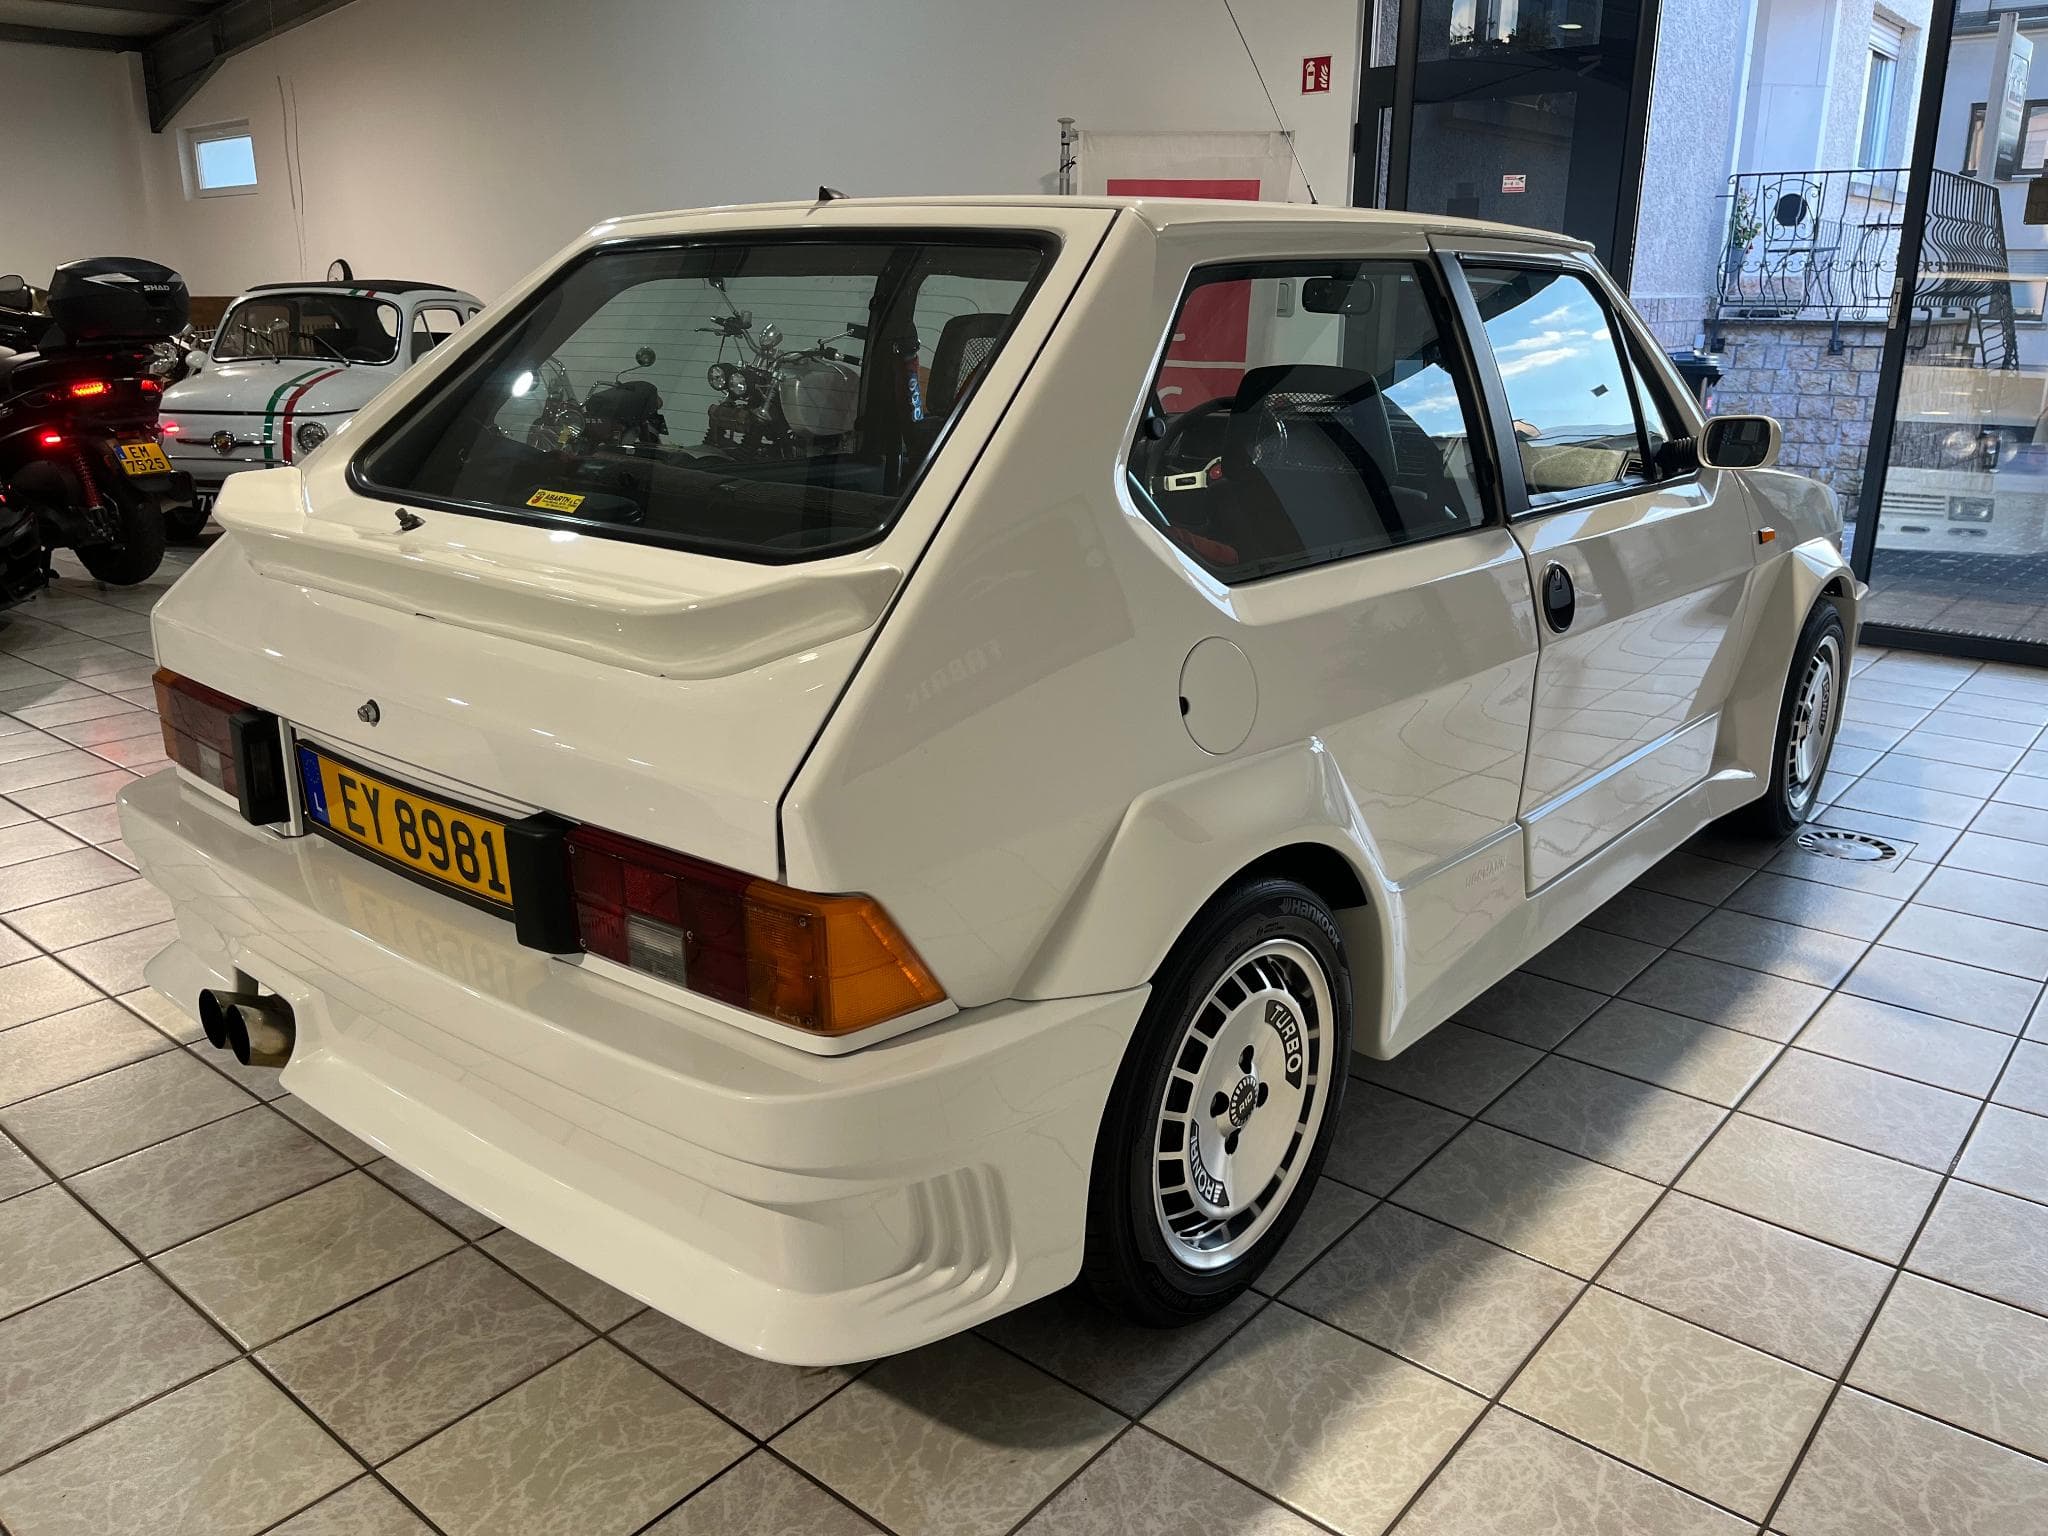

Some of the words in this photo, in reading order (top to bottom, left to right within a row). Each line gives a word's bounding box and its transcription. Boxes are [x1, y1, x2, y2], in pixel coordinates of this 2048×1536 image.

[126, 457, 166, 473] 7525
[128, 446, 150, 459] EM
[313, 791, 324, 813] L
[337, 772, 384, 846] EY
[394, 798, 507, 895] 8981
[1270, 1004, 1302, 1073] TURBO
[1190, 1124, 1215, 1201] RONAL
